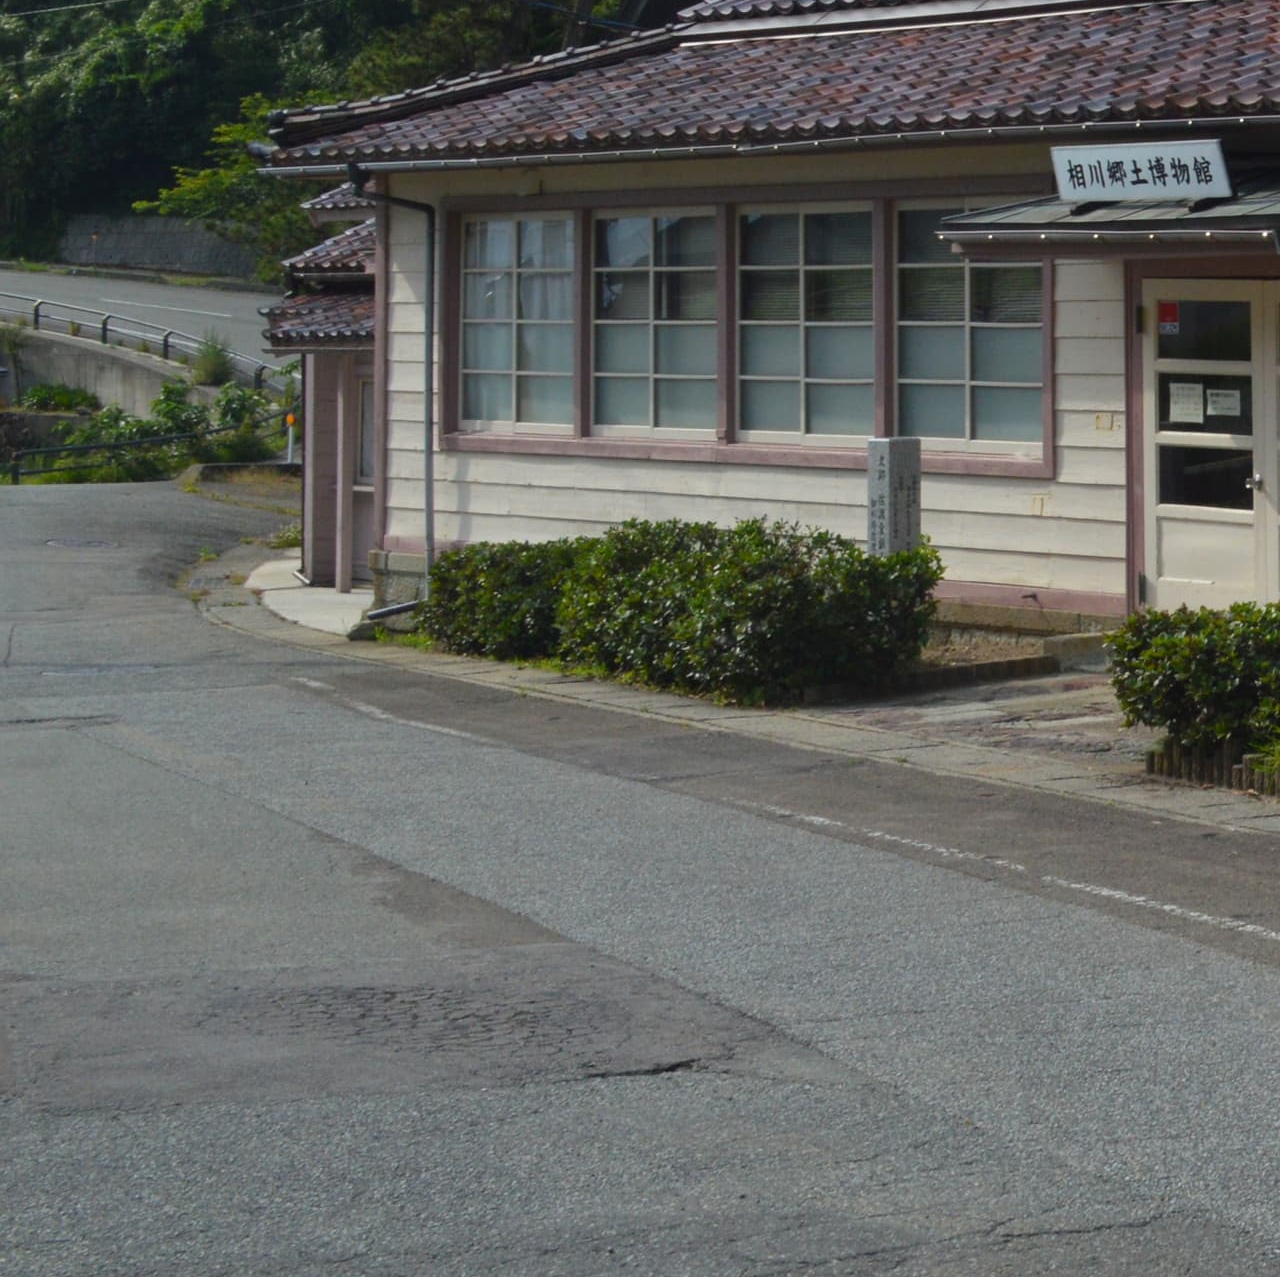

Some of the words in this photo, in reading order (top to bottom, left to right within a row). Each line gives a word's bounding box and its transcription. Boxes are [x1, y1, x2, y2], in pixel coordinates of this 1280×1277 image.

[1066, 157, 1214, 189] 相川郷土博物館
